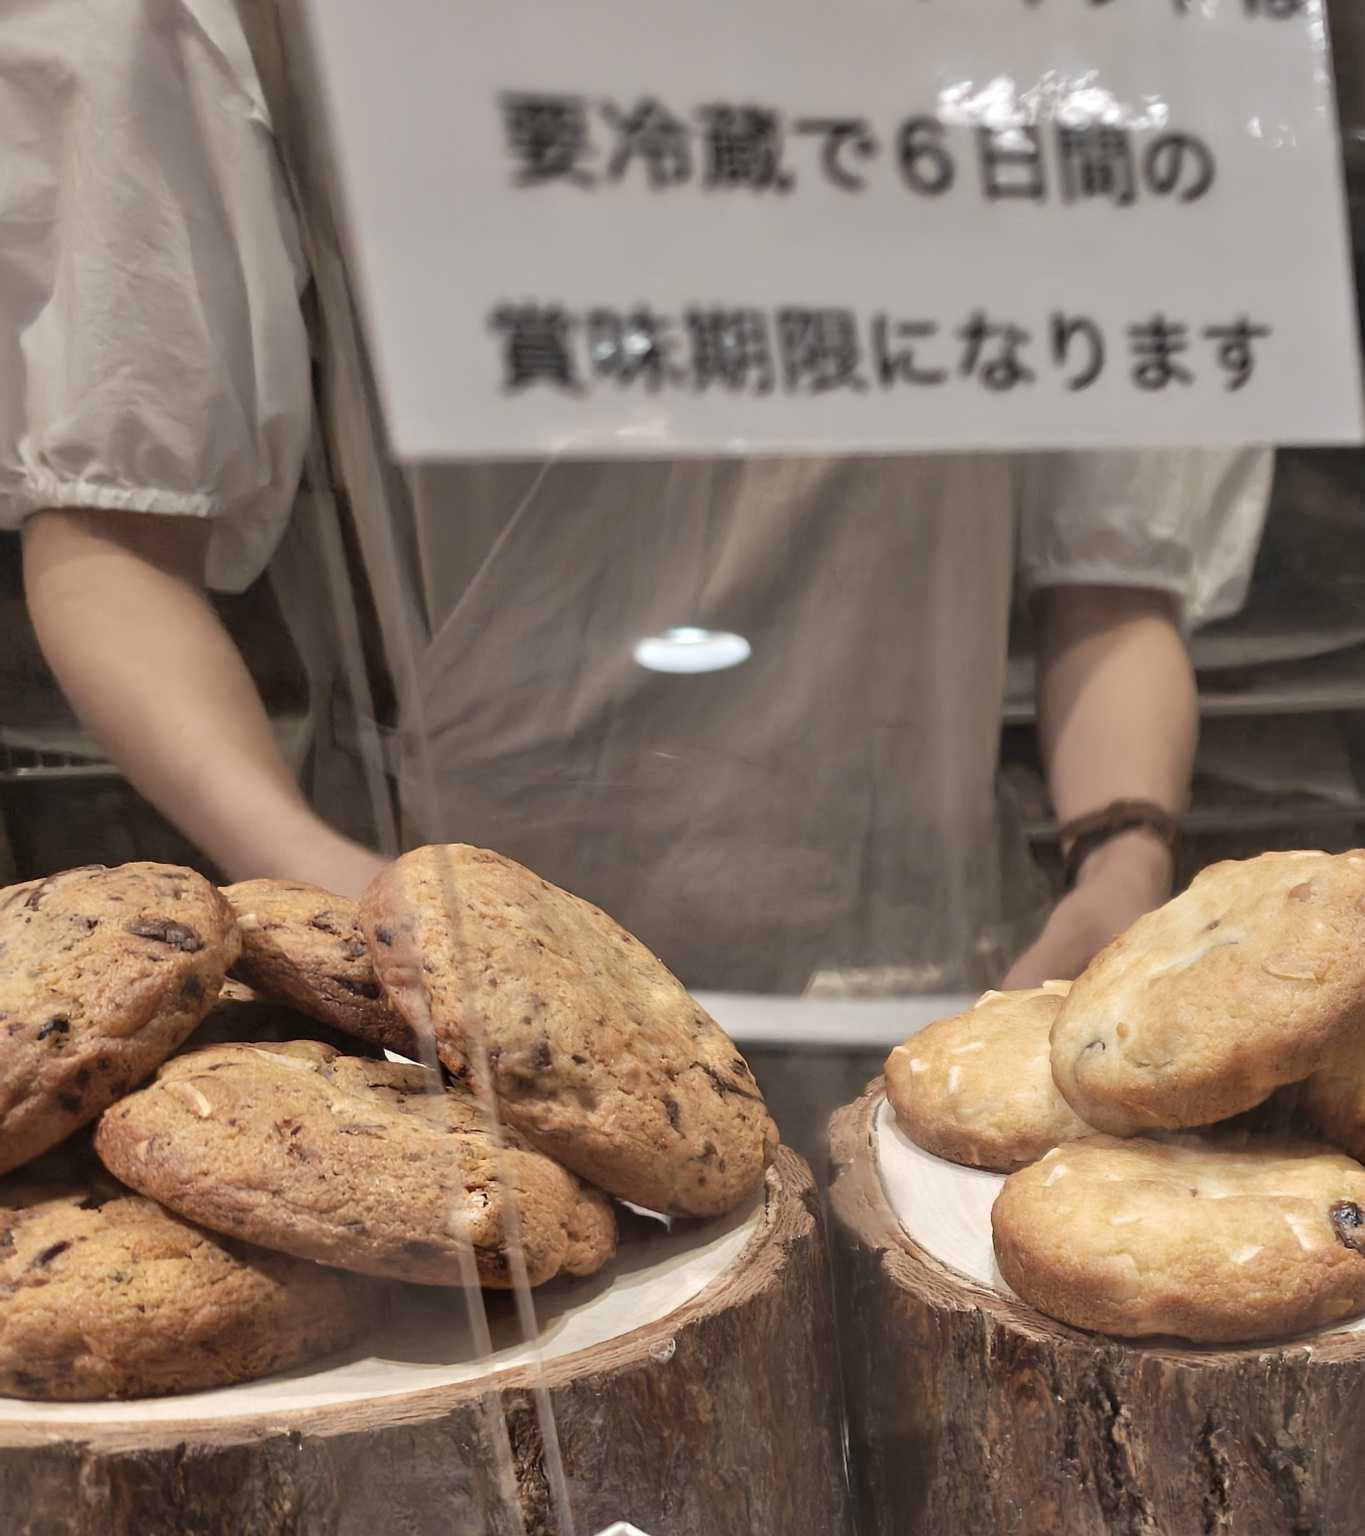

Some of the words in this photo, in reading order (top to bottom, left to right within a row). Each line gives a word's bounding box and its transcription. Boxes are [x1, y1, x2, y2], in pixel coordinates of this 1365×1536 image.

[486, 304, 1272, 398] 賞味期限になります
